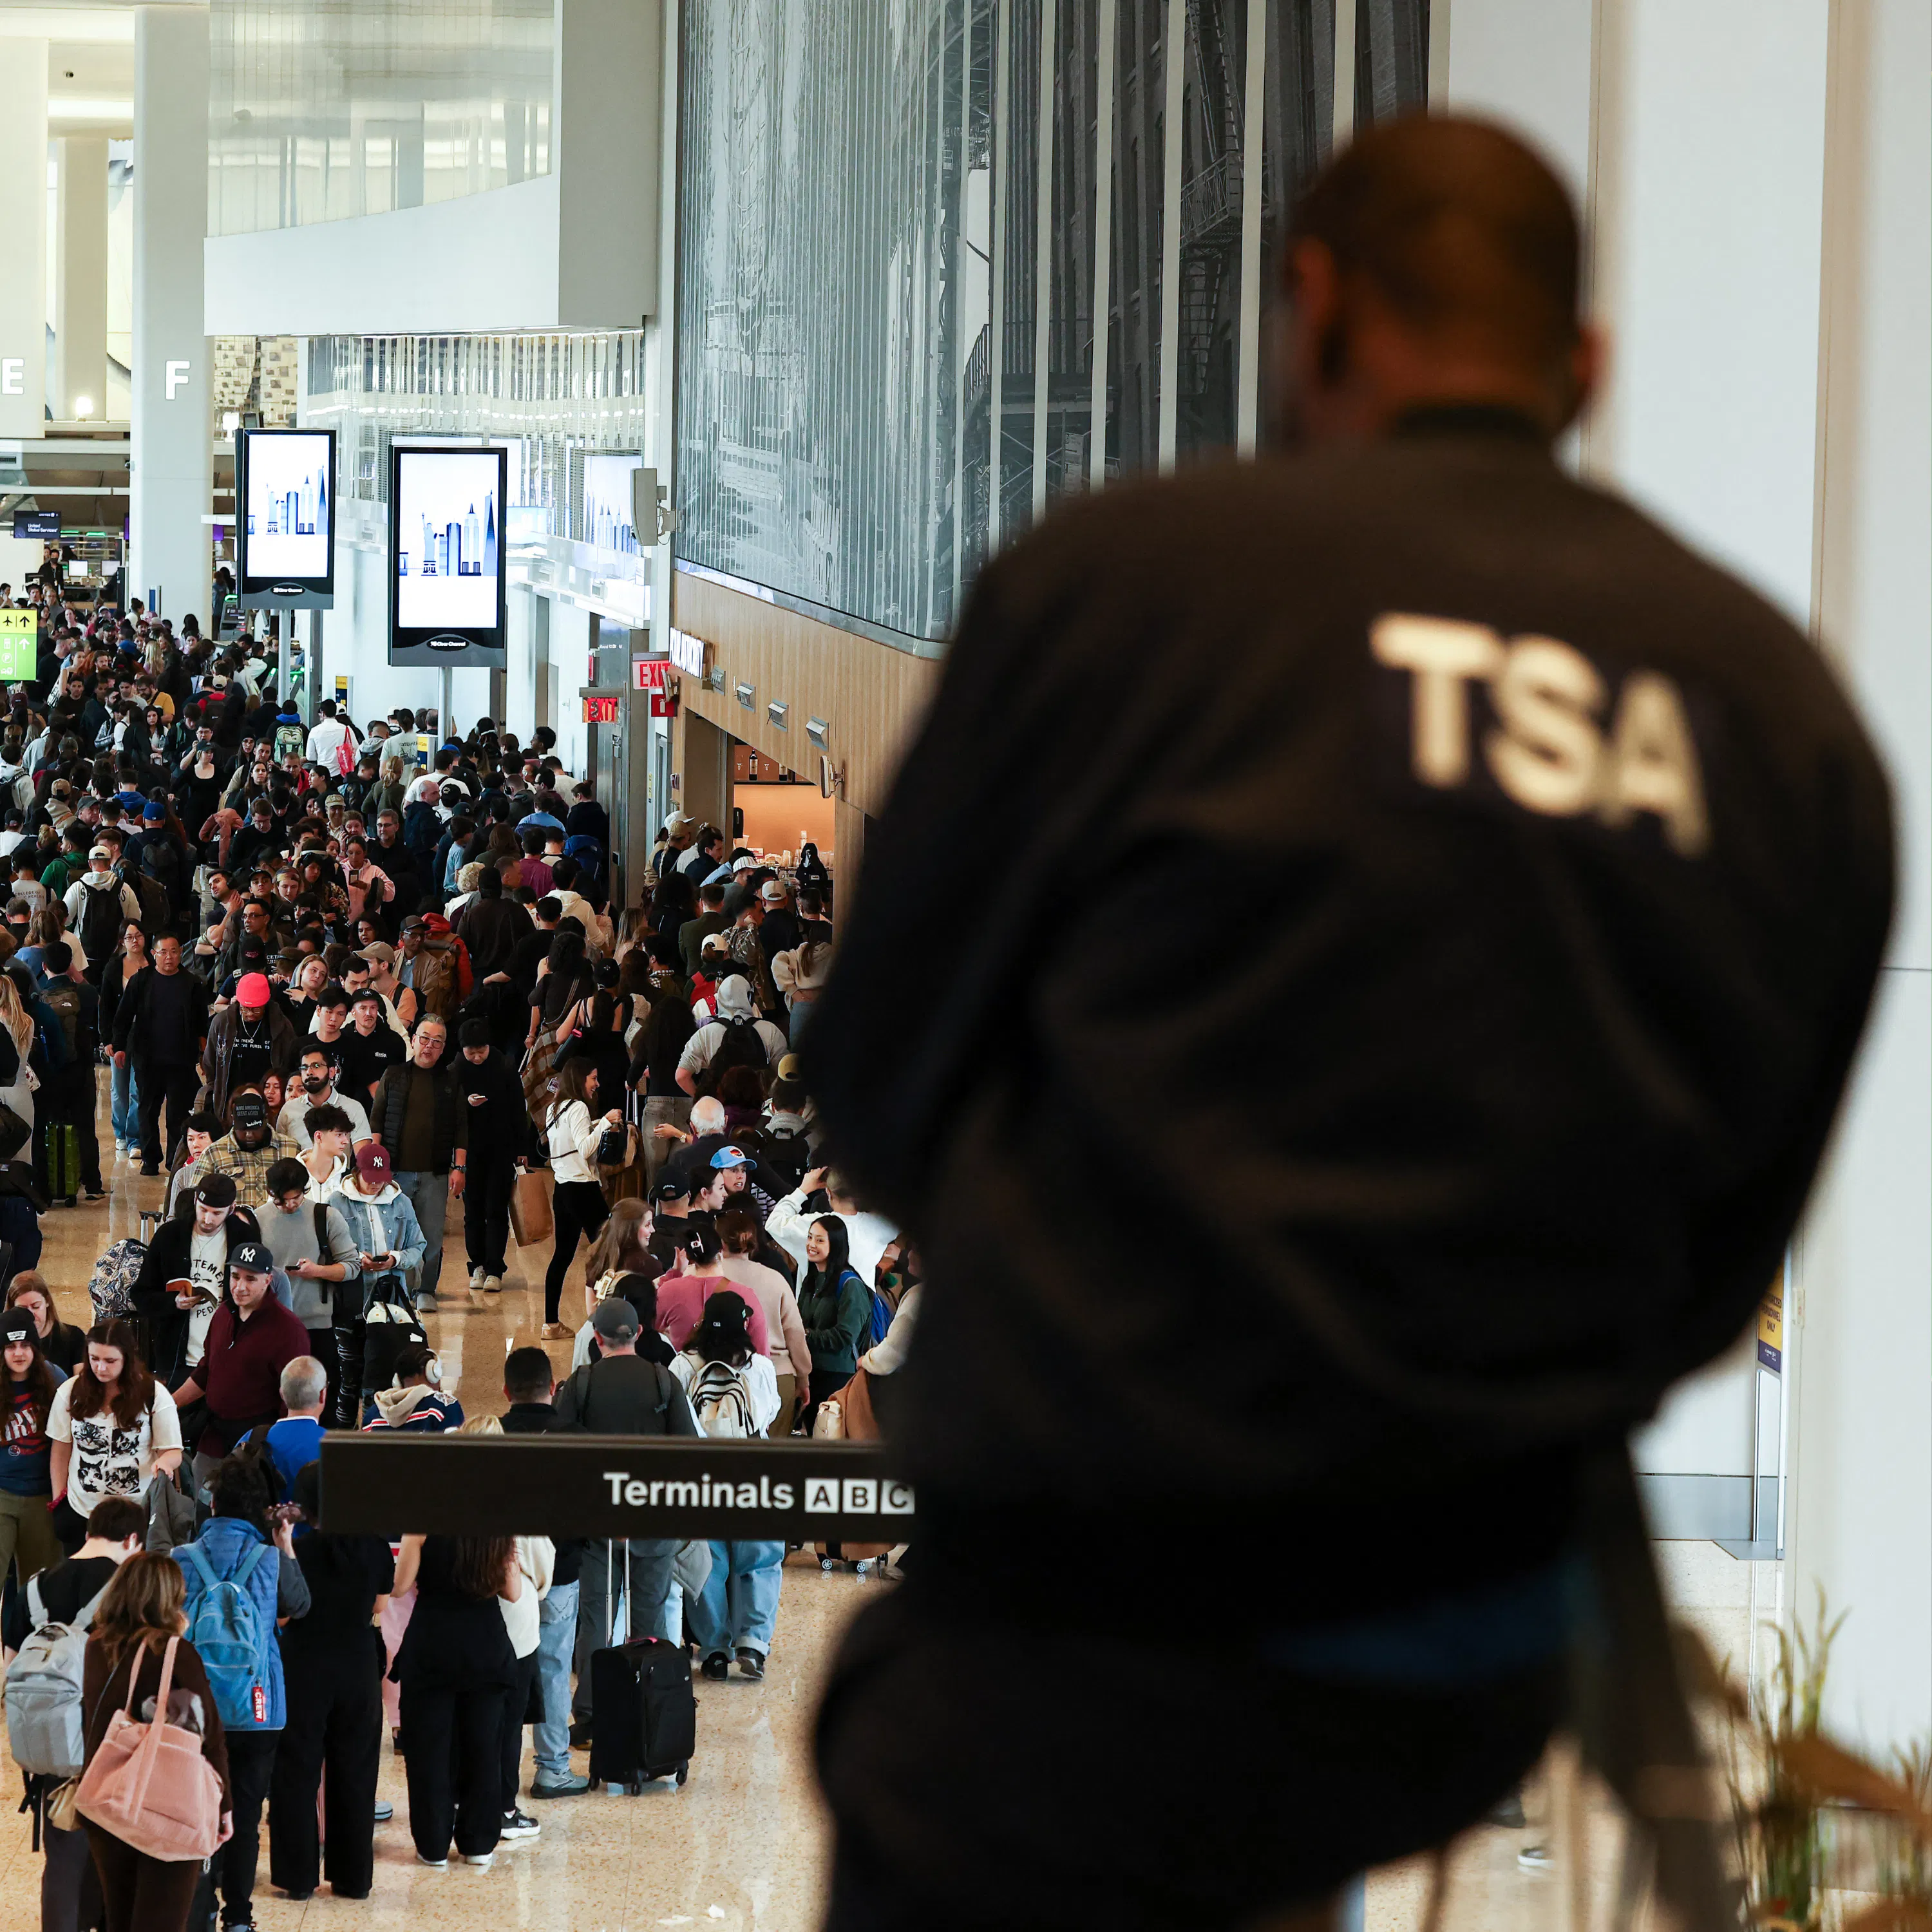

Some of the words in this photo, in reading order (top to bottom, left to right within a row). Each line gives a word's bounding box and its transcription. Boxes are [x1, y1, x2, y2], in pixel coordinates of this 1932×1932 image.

[2, 358, 24, 394] E
[166, 360, 190, 400] F
[639, 663, 670, 687] EXIT
[587, 697, 618, 721] EXIT
[1369, 612, 1712, 859] TSA
[240, 1247, 256, 1262] NY
[603, 1472, 795, 1510] Terminals
